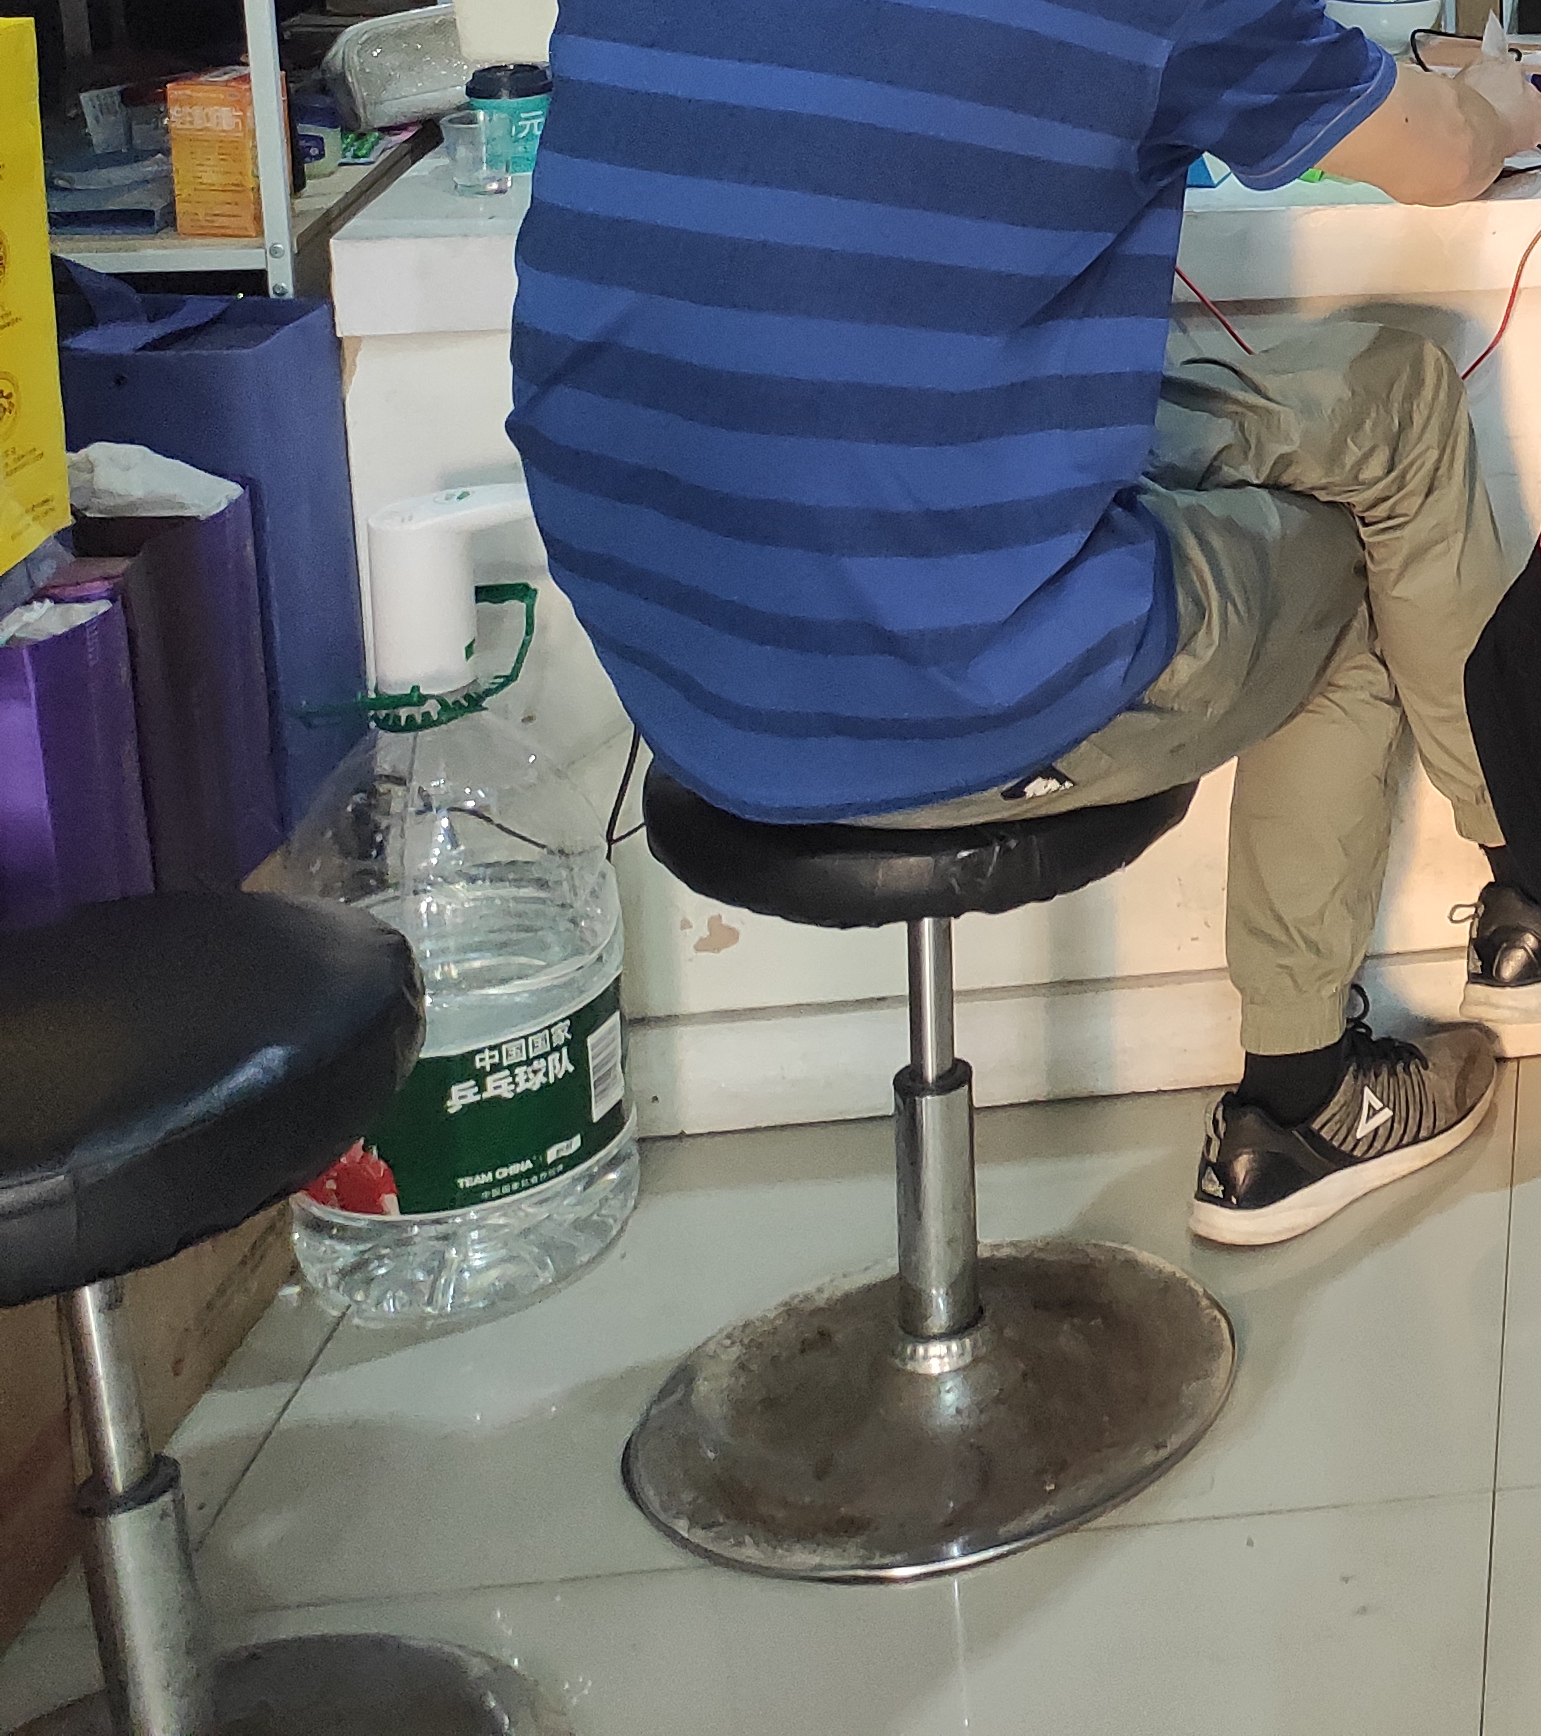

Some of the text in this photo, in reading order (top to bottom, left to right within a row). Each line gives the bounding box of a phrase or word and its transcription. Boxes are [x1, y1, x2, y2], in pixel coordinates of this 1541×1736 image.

[474, 1018, 573, 1073] 中国国家
[445, 1045, 575, 1114] 乒乓球队
[456, 1158, 534, 1189] TEAM CHINA
